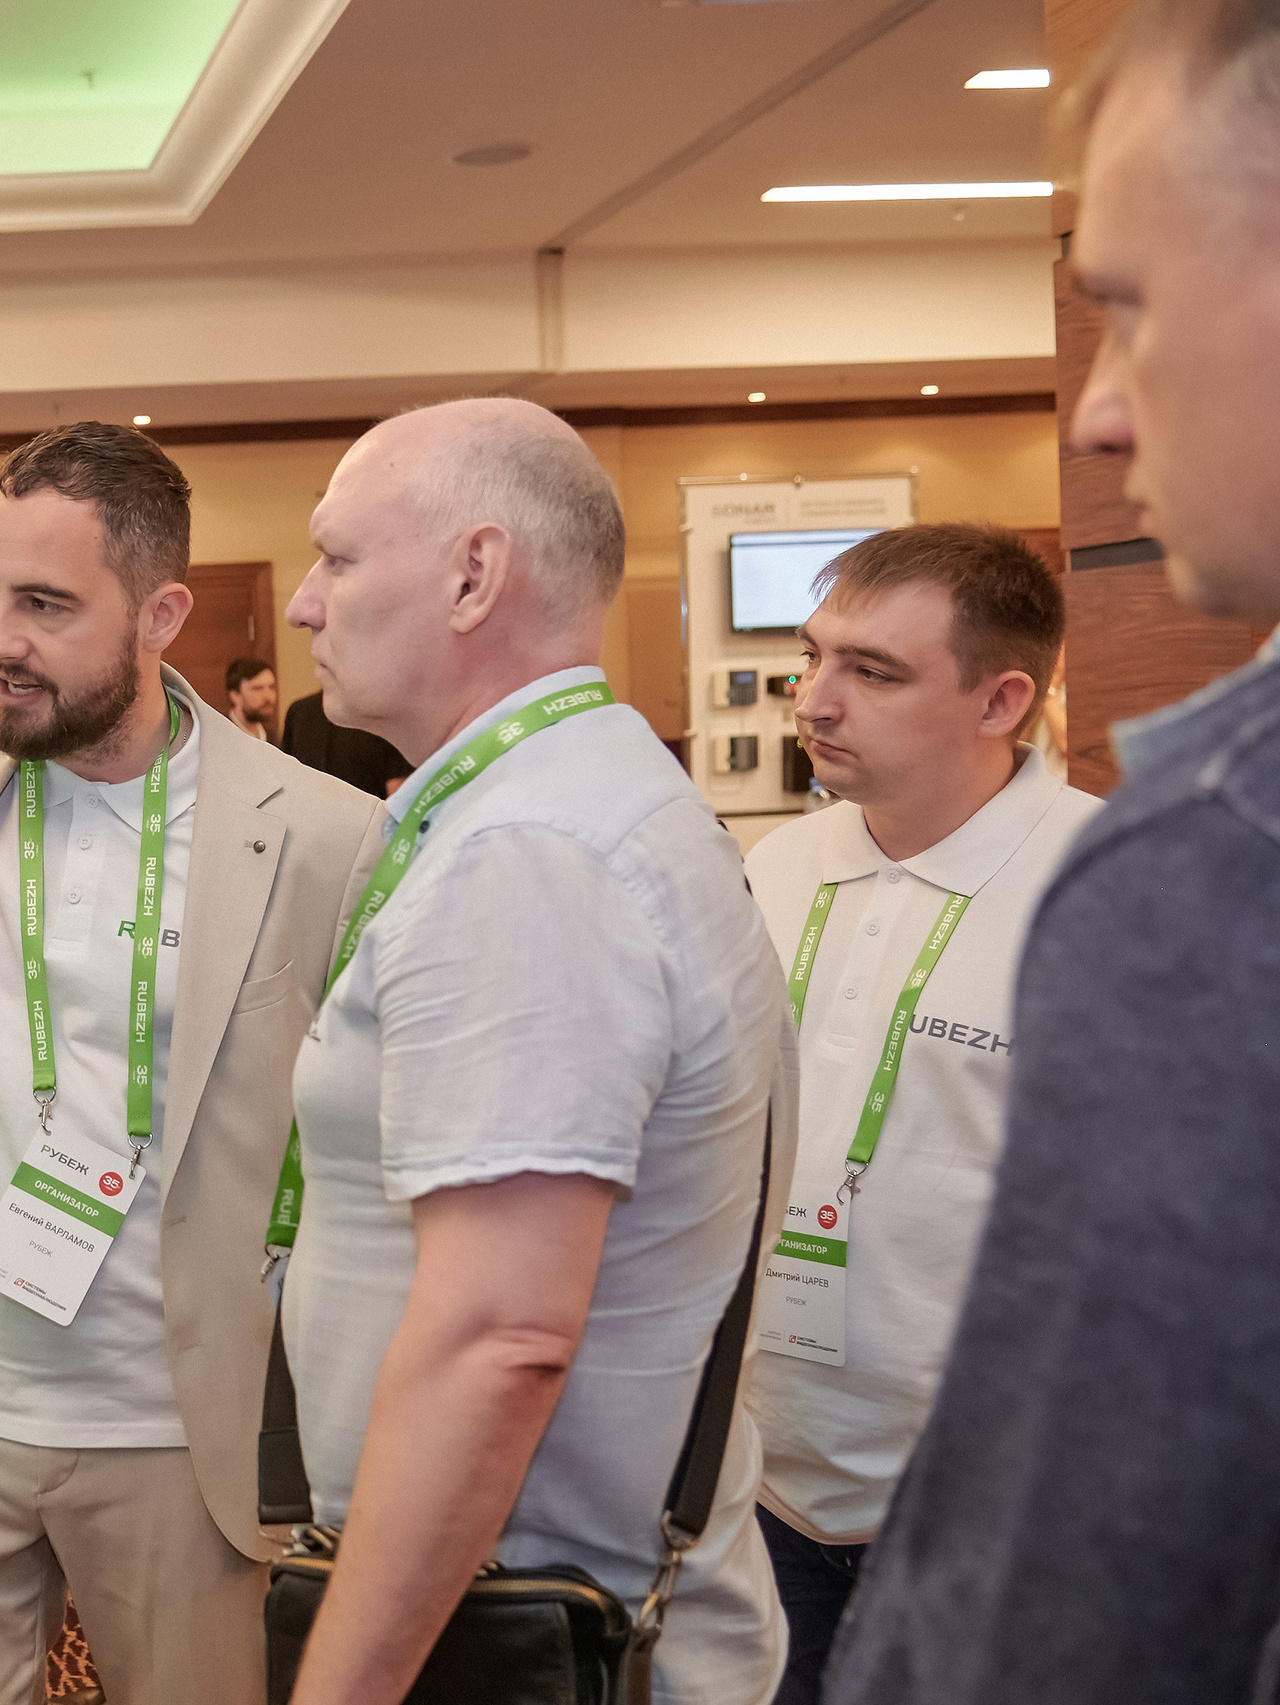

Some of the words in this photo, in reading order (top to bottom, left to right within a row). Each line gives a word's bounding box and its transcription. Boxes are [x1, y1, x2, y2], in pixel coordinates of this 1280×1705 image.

[542, 689, 604, 715] RUBEZH
[498, 721, 525, 745] 35
[150, 752, 163, 793] BEZH
[413, 755, 476, 814] RUBEZH
[26, 761, 36, 818] RUBEZH
[149, 813, 161, 834] 35
[24, 840, 35, 860] 35
[392, 839, 410, 865] 35
[143, 857, 156, 916] RUBEZH
[816, 891, 828, 908] 35
[27, 879, 36, 936] RUBEZH
[929, 895, 964, 950] RUBEZH
[141, 936, 153, 957] 35
[795, 926, 817, 980] RUBEZH
[28, 959, 37, 979] 35
[911, 969, 926, 987] 35
[135, 981, 147, 1043] RUBEZH
[33, 1000, 47, 1061] RUBEZH
[883, 1010, 907, 1071] RUBEZH
[909, 1013, 1014, 1057] UBEZH
[136, 1065, 147, 1085] 35
[871, 1092, 885, 1113] 35
[41, 1144, 89, 1175] РУБЕЖ
[102, 1175, 120, 1189] 35
[35, 1180, 99, 1217] ОРГАНИЗАТОР
[9, 1203, 44, 1226] Евгений
[45, 1221, 94, 1253] ВАРЛАМОВ
[820, 1210, 834, 1220] 35
[29, 1240, 53, 1258] РУБЕЖ
[766, 1268, 800, 1283] Дмитрий
[802, 1275, 829, 1288] ЦАРЕВ
[786, 1296, 806, 1306] РУБЕЖ
